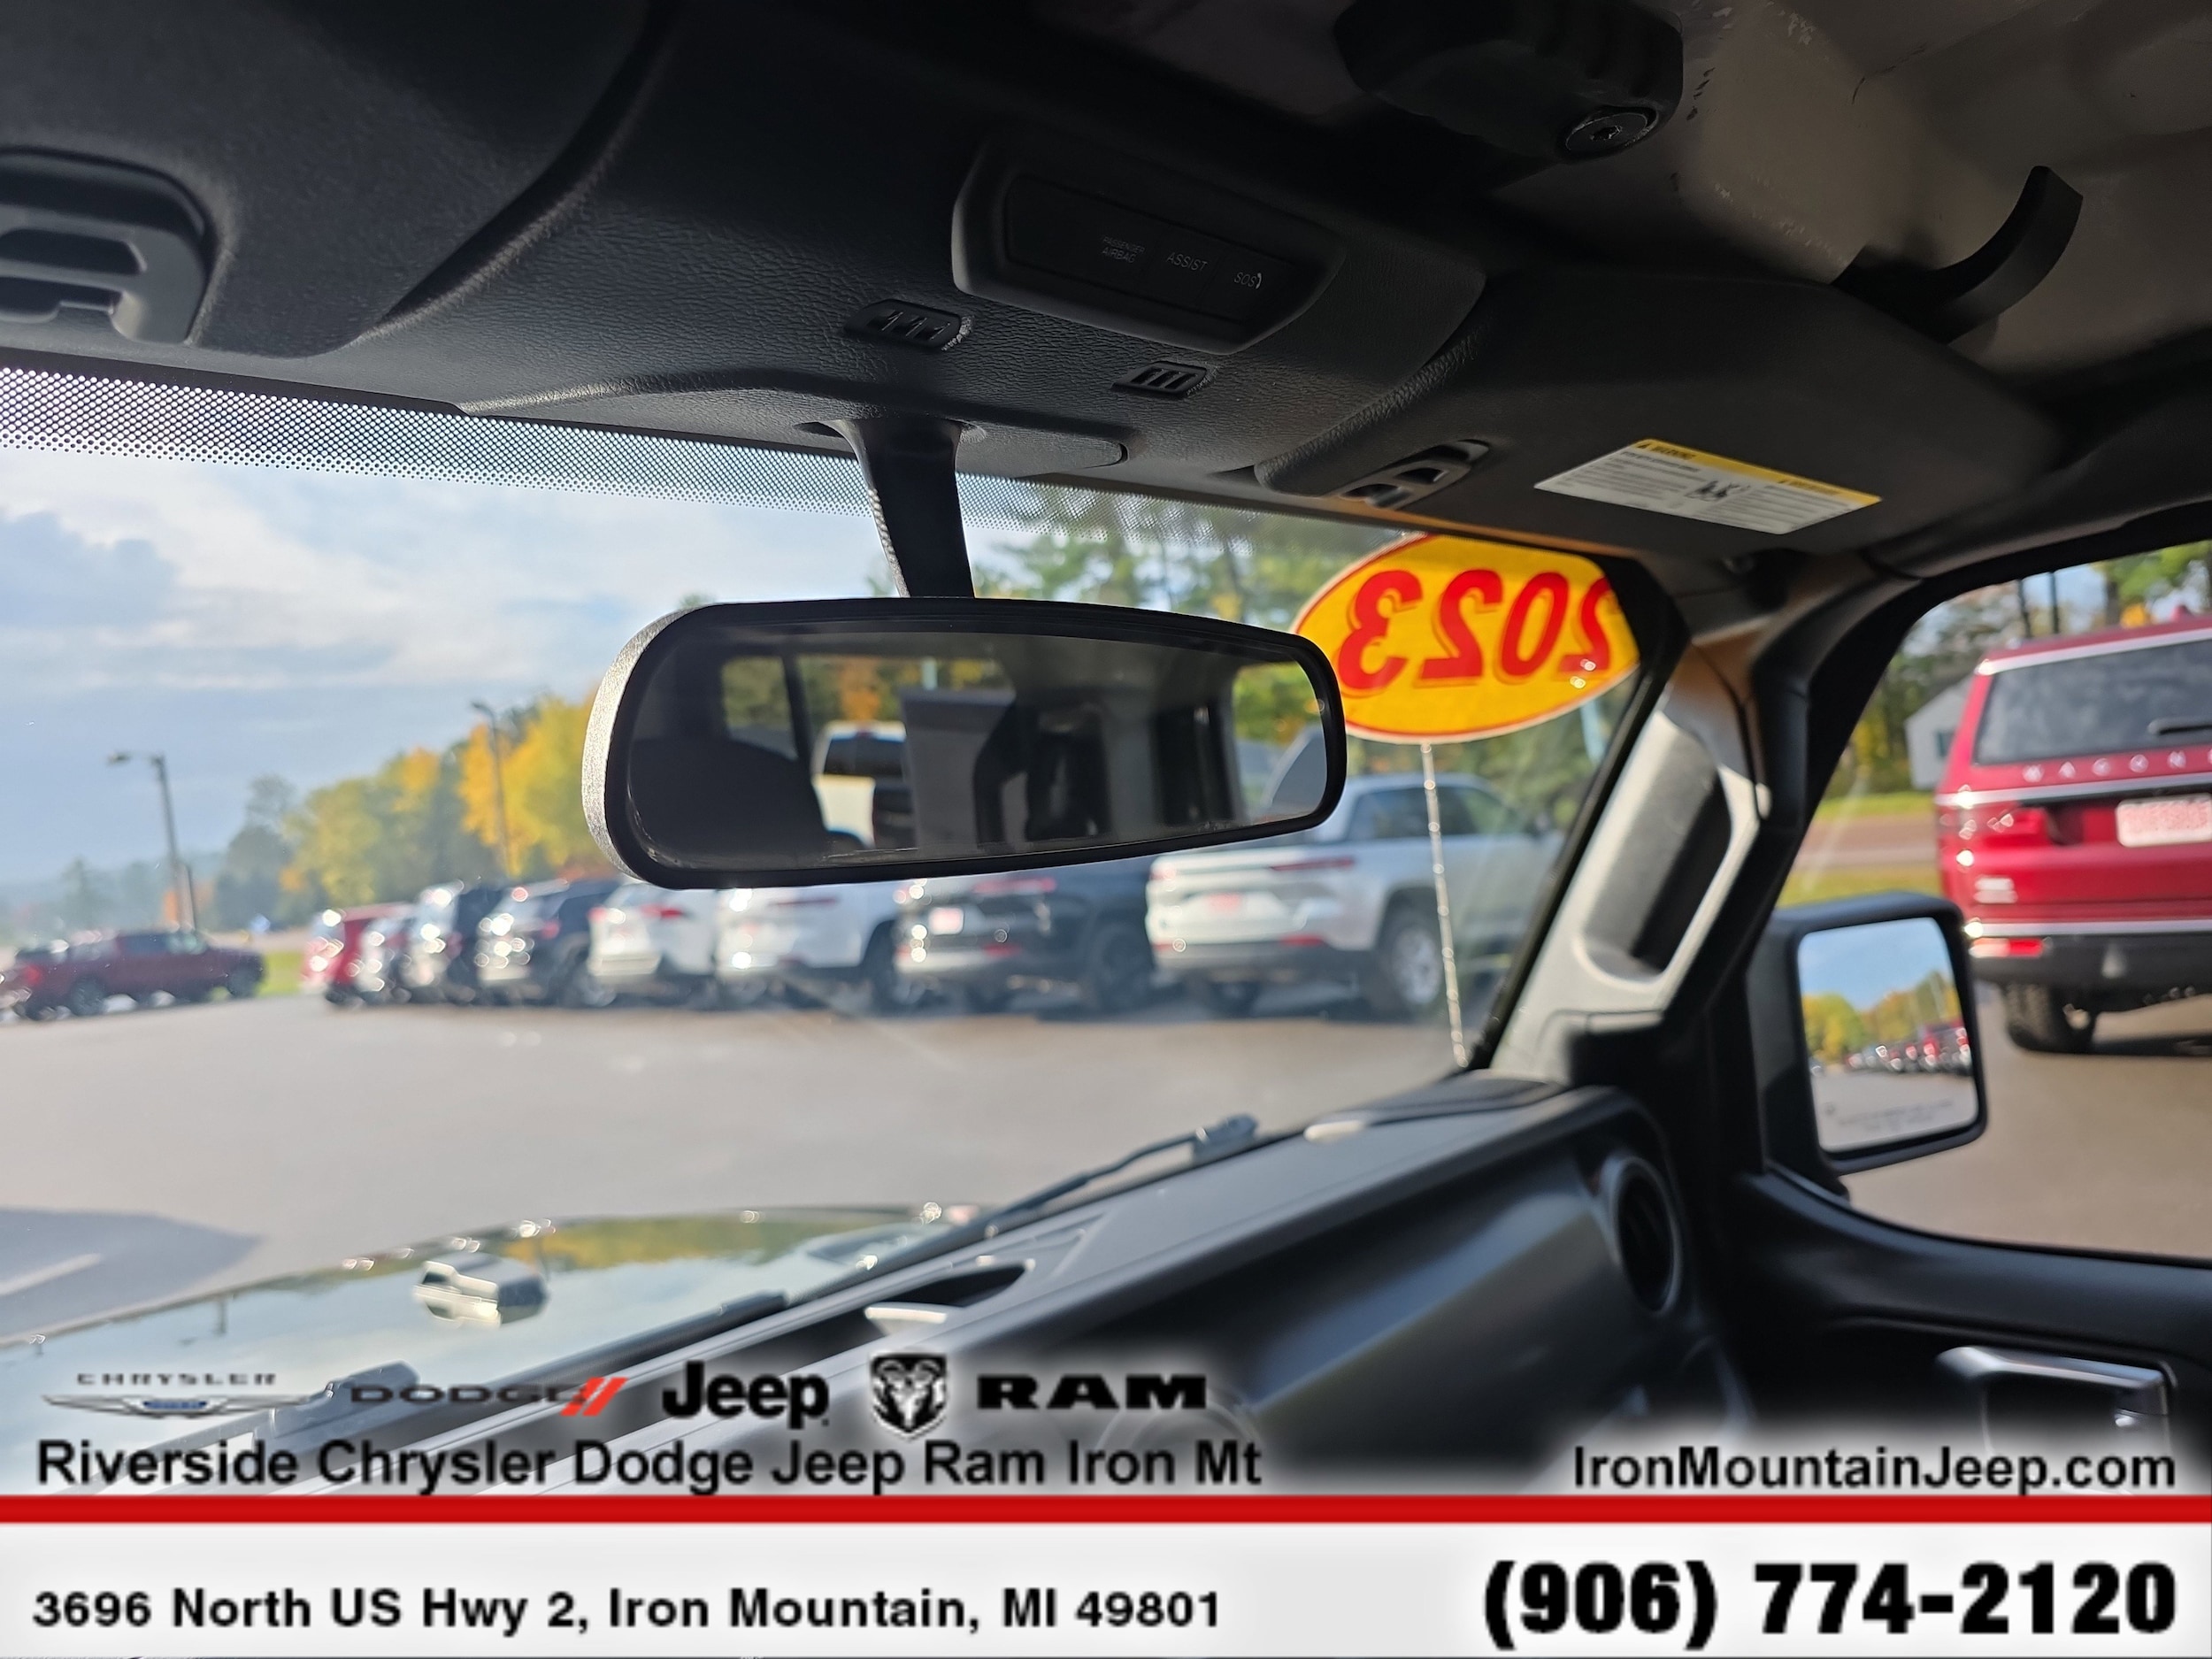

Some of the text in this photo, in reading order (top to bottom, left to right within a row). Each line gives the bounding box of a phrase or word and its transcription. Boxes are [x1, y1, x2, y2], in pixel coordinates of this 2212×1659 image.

[1102, 247, 1137, 264] AIRBAG
[1166, 252, 1209, 272] ASSIST
[1233, 272, 1256, 288] SOS
